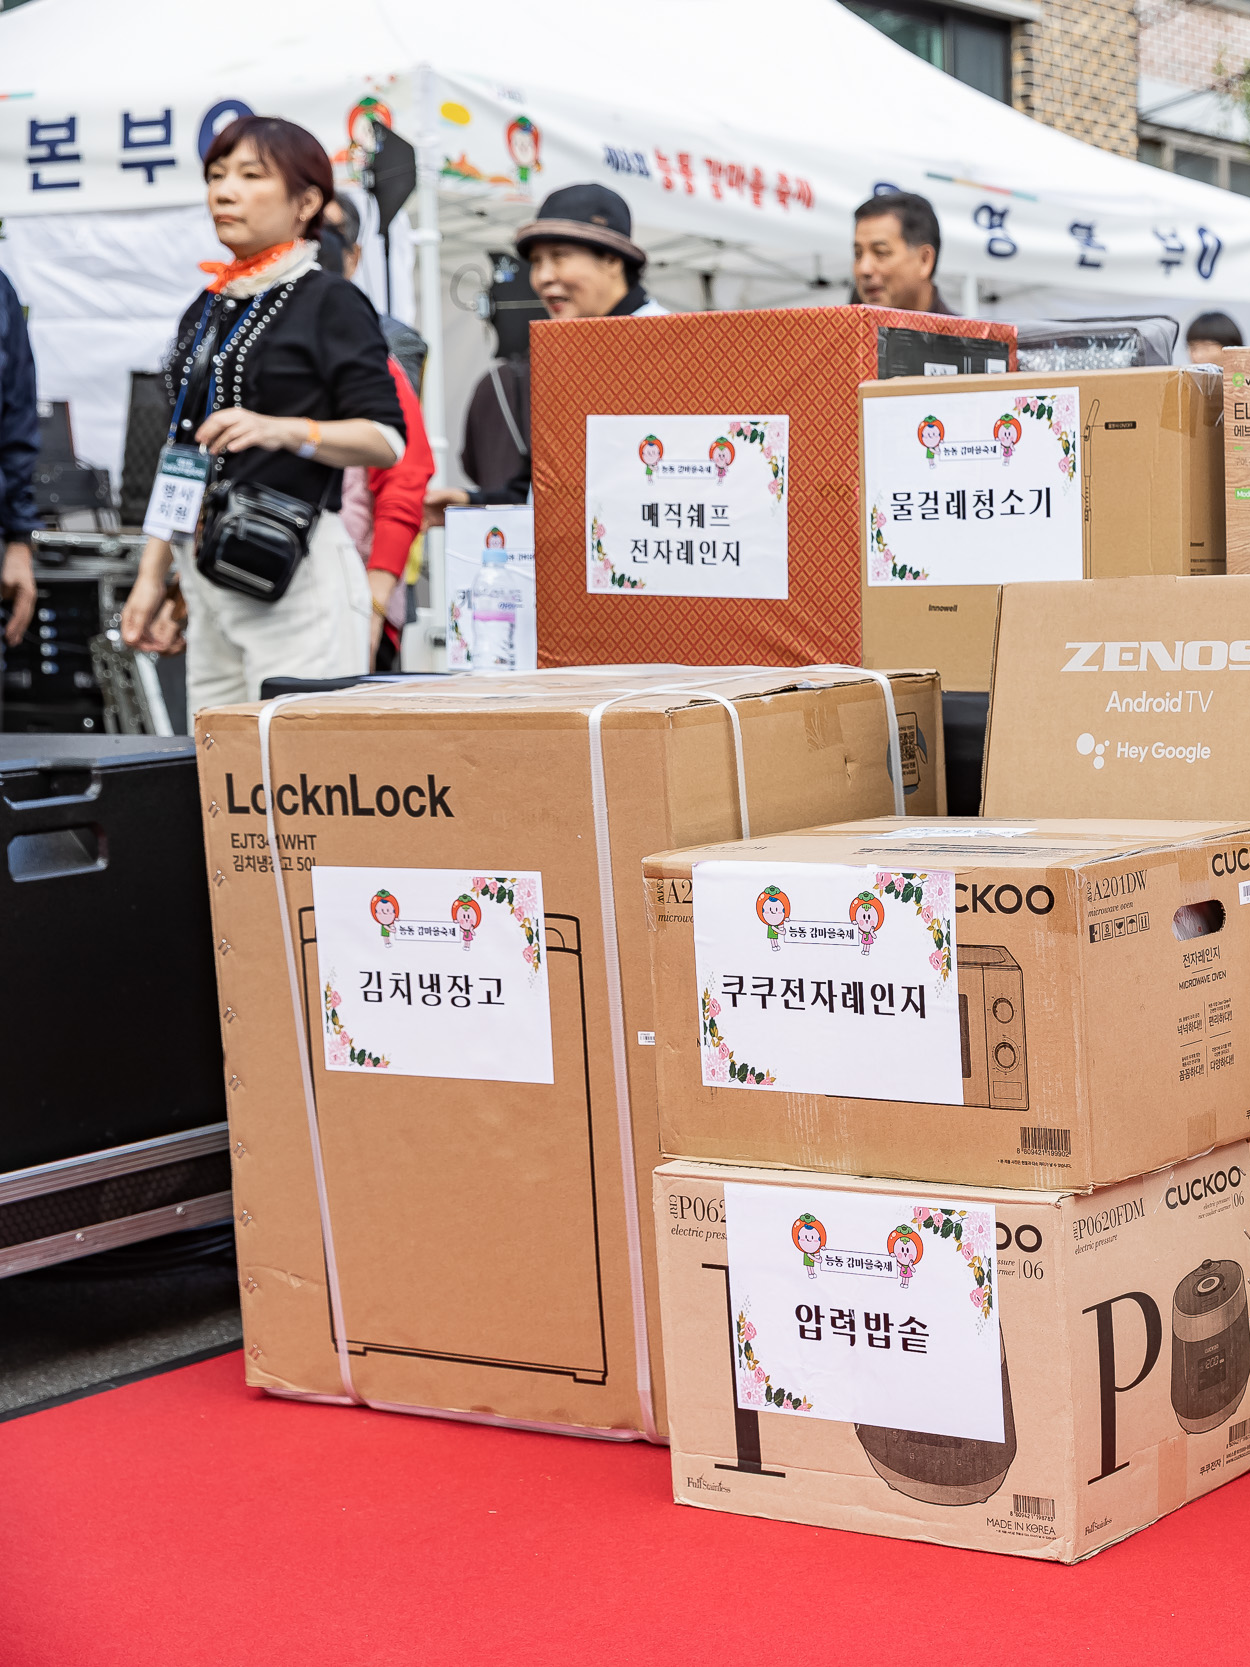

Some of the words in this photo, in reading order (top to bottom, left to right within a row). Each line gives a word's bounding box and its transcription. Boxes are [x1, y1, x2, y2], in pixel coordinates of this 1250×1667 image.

[642, 502, 730, 528] 매직쉐프
[890, 486, 1052, 521] 물걸레청소기
[630, 538, 740, 566] 전자레인지
[1105, 690, 1183, 714] Android
[1185, 690, 1214, 713] TV
[1116, 741, 1149, 764] Hey
[1152, 741, 1212, 764] Google
[225, 773, 456, 818] LocknLock
[1094, 868, 1148, 901] A201DW
[1088, 904, 1119, 918] microwave
[1119, 900, 1134, 912] oven
[788, 926, 807, 940] 능동
[809, 926, 855, 941] 감마을축제
[1182, 945, 1220, 968] 전자레인지
[358, 969, 506, 1008] 김치냉장고
[1178, 973, 1211, 990] MICROWAVE
[1212, 970, 1227, 982] OVEN
[721, 974, 926, 1020] 쿠쿠전자레인지
[1165, 1166, 1242, 1210] CUCKOO
[1234, 1191, 1245, 1208] 06
[668, 1194, 678, 1219] CRP
[1078, 1198, 1146, 1240] P0620FDM
[671, 1224, 704, 1238] electric
[705, 1230, 728, 1242] pres
[1074, 1239, 1094, 1255] electric
[824, 1254, 844, 1268] 능동
[846, 1256, 894, 1274] 감마을축제
[1023, 1260, 1044, 1280] 06
[794, 1303, 930, 1355] 압력밥솥
[1082, 1291, 1162, 1486] P
[986, 1518, 1012, 1530] MADE
[1014, 1521, 1024, 1530] IN
[1026, 1522, 1056, 1536] KOREA
